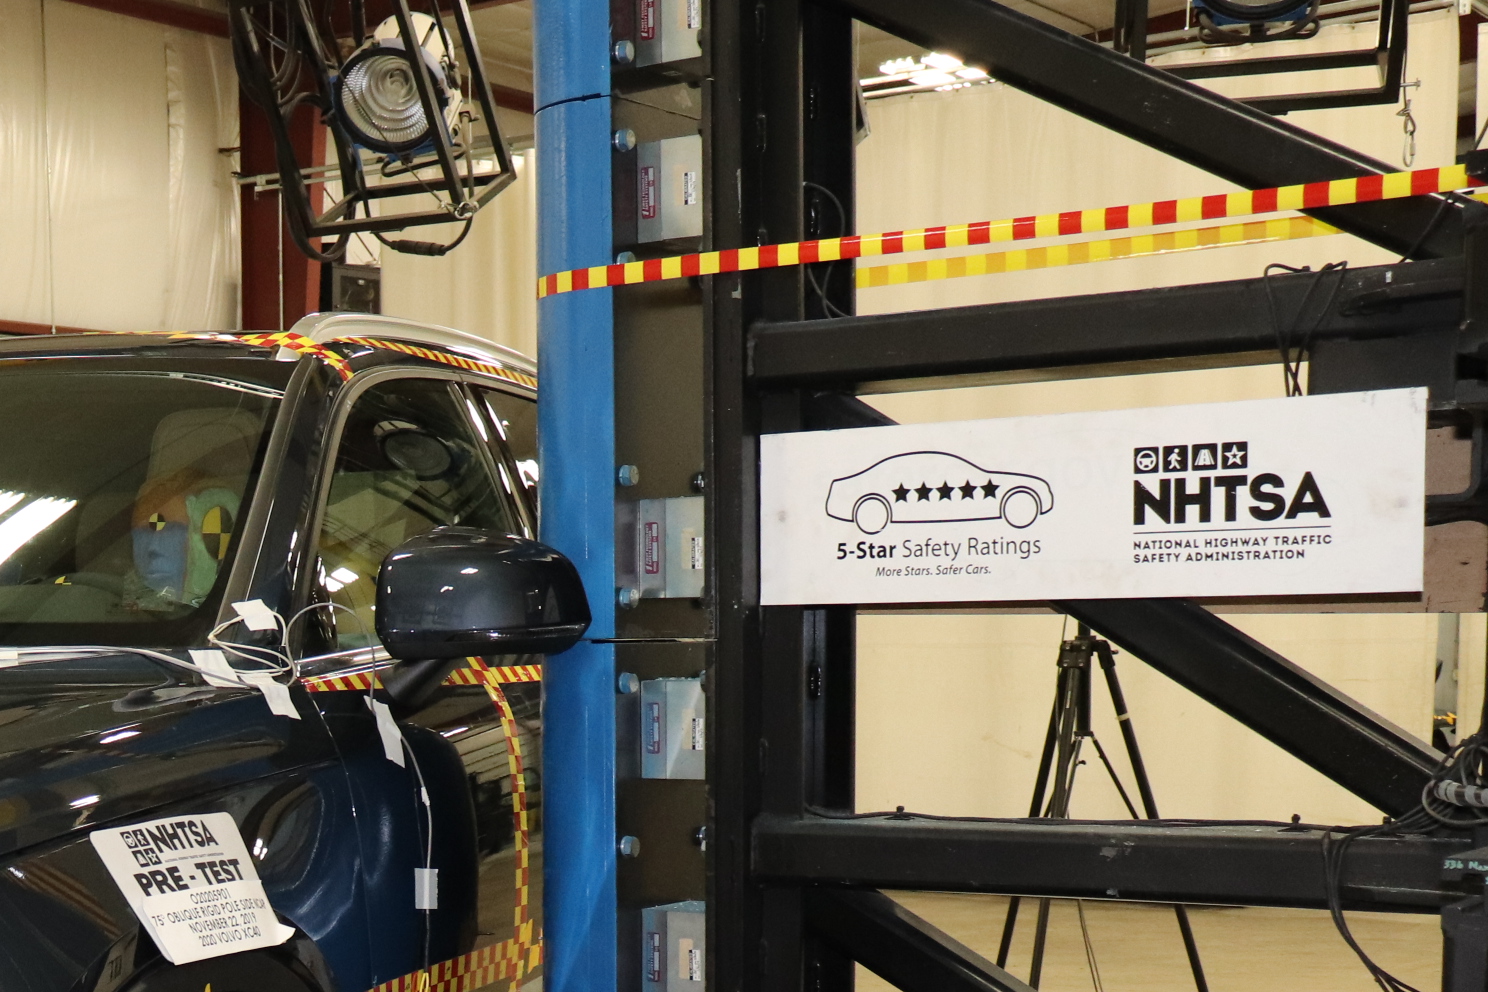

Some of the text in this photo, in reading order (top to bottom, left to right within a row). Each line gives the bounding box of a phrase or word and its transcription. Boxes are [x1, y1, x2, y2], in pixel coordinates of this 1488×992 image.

[1133, 471, 1332, 525] NHTSA
[836, 536, 1042, 561] 5-Star Safety Ratings
[1133, 534, 1332, 550] NATIONAL HIGHWAY TRAFFIC
[1133, 549, 1306, 564] SAFETY ADMINISTRATION
[875, 564, 992, 577] More Stars. Safer Cars.
[145, 820, 219, 853] NHTSA
[133, 866, 190, 897] PRE
[194, 858, 244, 886] TEST
[166, 907, 202, 924] OBLIQUE
[200, 904, 221, 917] RIGID
[220, 900, 241, 914] POLE
[240, 898, 255, 910] SIDE
[188, 912, 258, 933] NOVEMBER 22, 2019
[199, 926, 261, 947] 2020 VOLVO XC40
